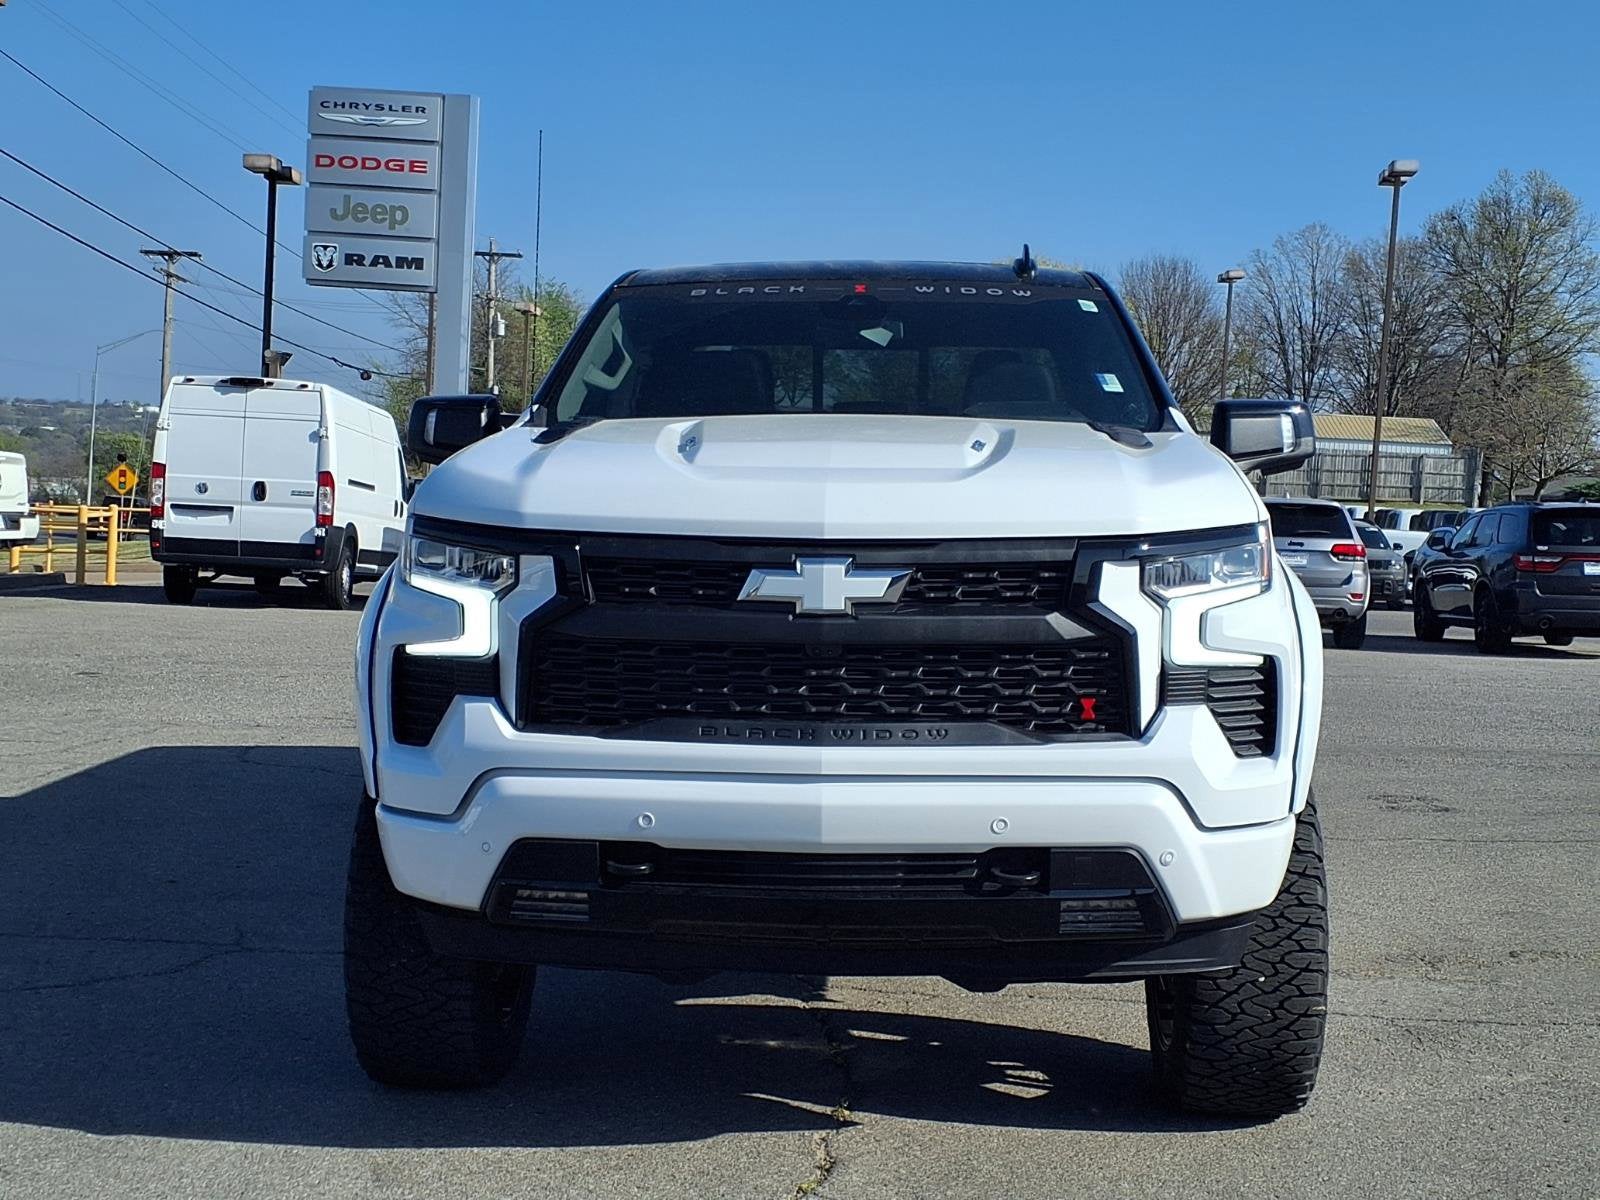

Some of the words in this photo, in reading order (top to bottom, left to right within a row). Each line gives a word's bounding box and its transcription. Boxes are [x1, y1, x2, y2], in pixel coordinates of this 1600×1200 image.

[319, 100, 427, 114] CHRYSLER
[314, 154, 428, 174] DODGE
[329, 194, 410, 230] Jeep
[344, 252, 425, 271] RAM
[690, 285, 805, 297] BLACK
[914, 285, 1032, 297] WIDOW
[698, 726, 816, 741] BLACK
[830, 728, 949, 742] WIDOW
